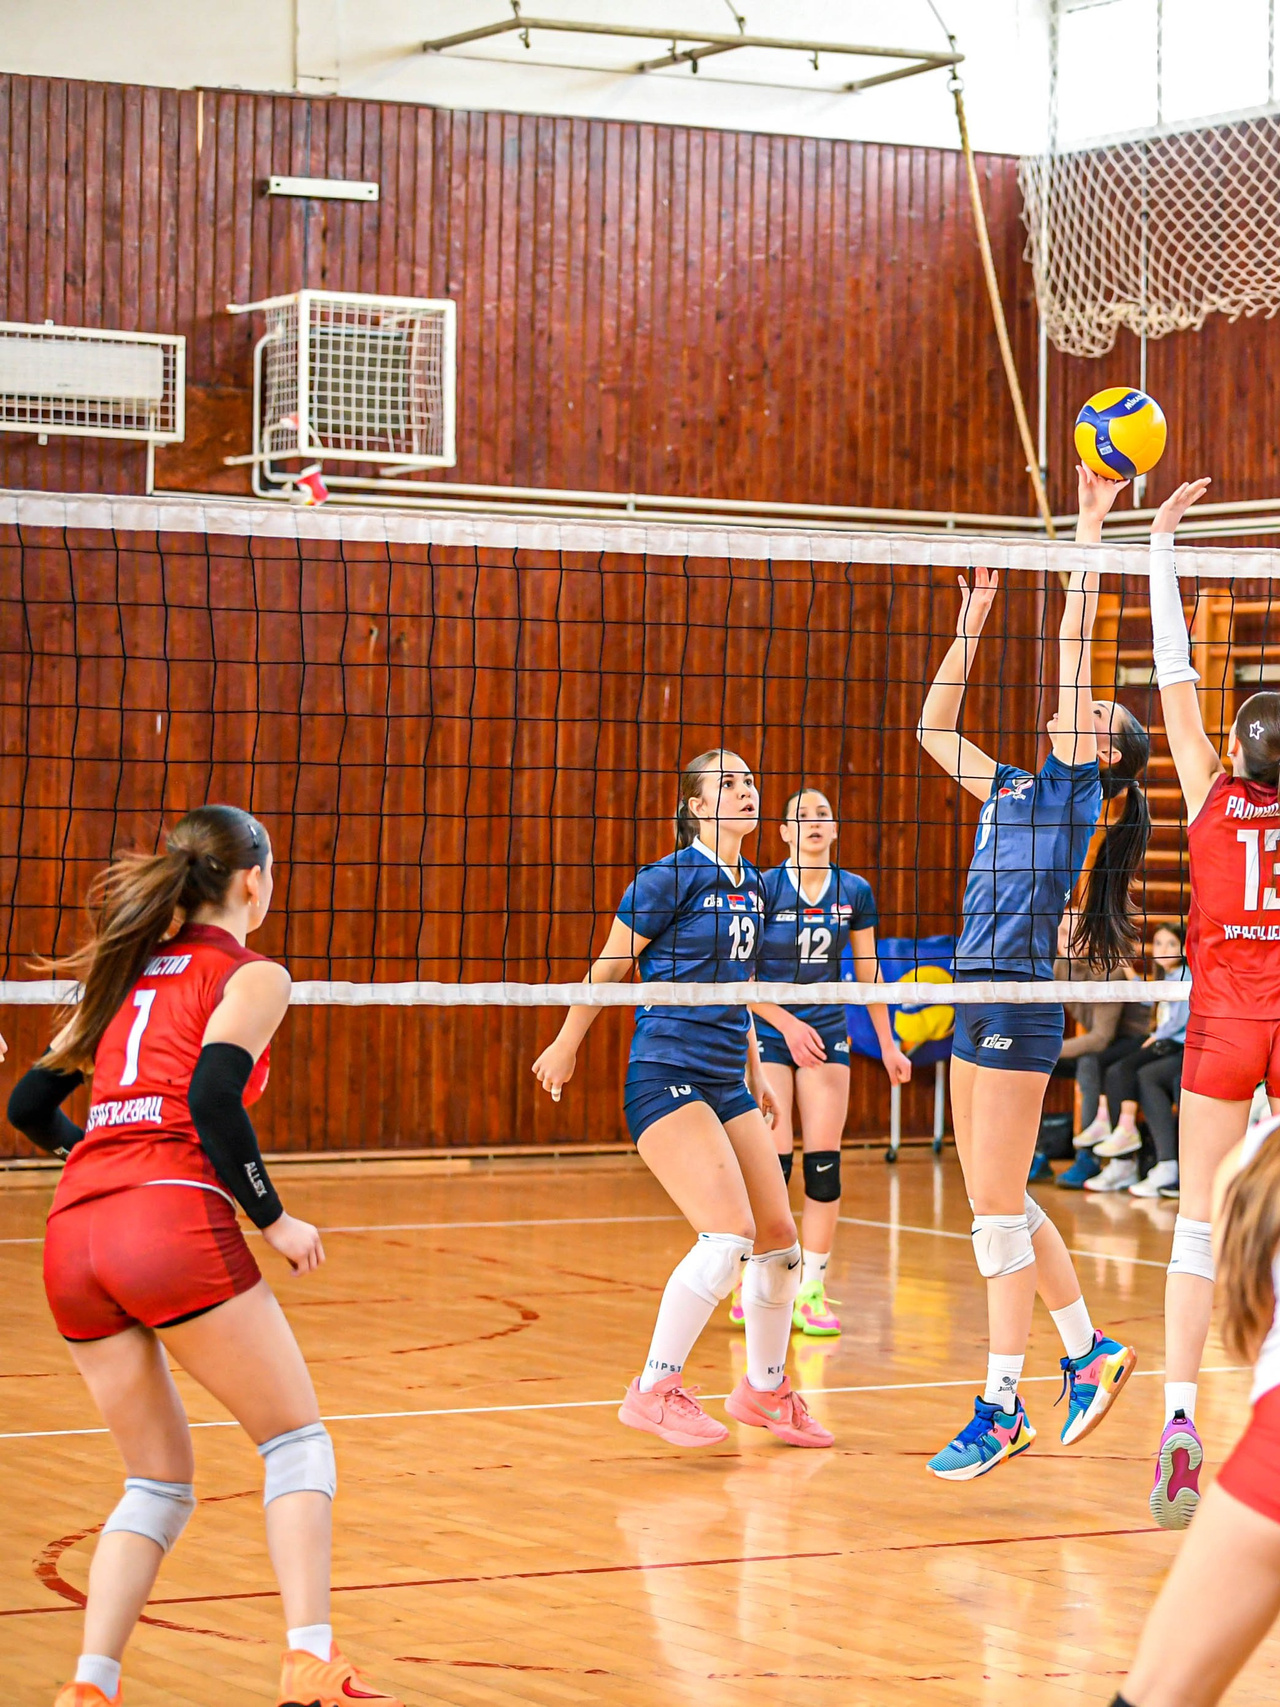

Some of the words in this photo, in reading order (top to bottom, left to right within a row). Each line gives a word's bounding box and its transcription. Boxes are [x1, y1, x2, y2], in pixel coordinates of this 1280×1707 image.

[729, 915, 756, 962] 13
[796, 927, 833, 964] 12
[119, 988, 157, 1087] 1
[982, 1033, 1013, 1050] da
[649, 1359, 682, 1373] KIPST
